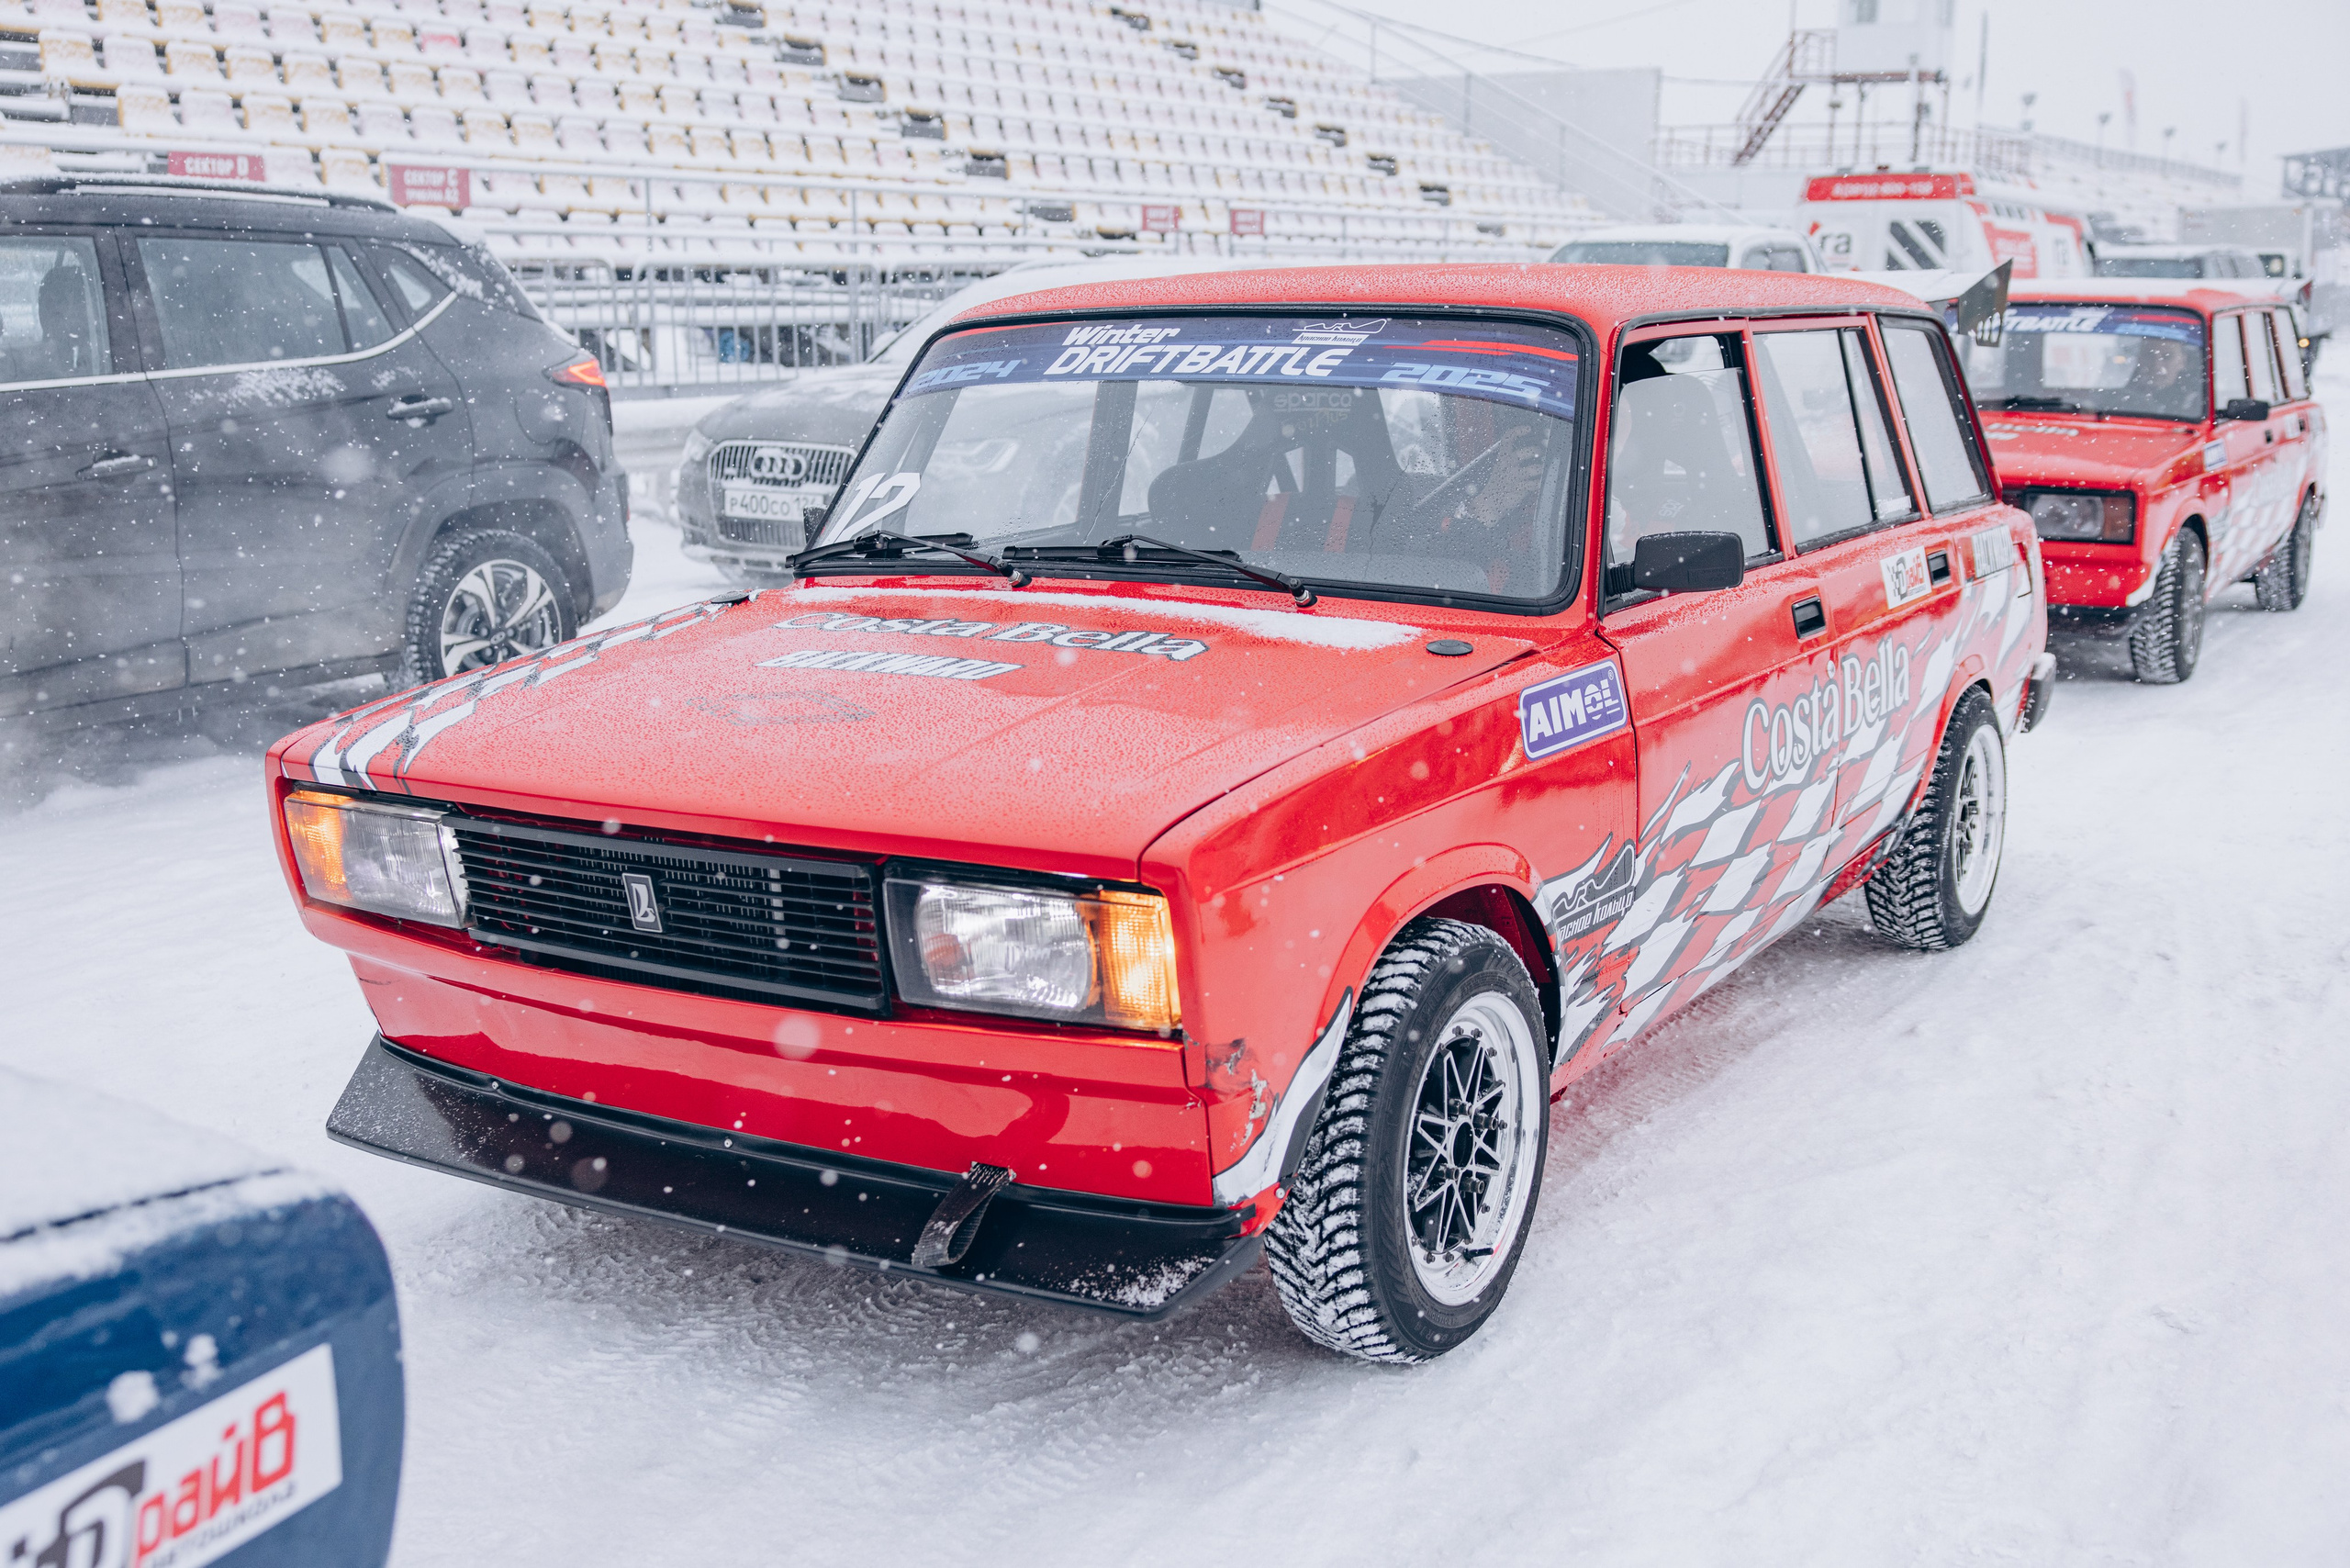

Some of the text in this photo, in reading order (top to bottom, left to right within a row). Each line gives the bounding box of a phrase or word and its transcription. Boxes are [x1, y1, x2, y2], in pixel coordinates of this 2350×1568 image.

[1062, 323, 1181, 346] Winter
[907, 358, 1023, 394] 2024
[1043, 345, 1354, 376] DRIFTBATTLE
[1379, 362, 1551, 399] 2025
[1274, 392, 1352, 412] sparco
[821, 472, 921, 549] 12
[773, 612, 1211, 663] Costa Bella
[753, 650, 1026, 680] BACKWARD
[1743, 635, 1910, 791] Costa Bella
